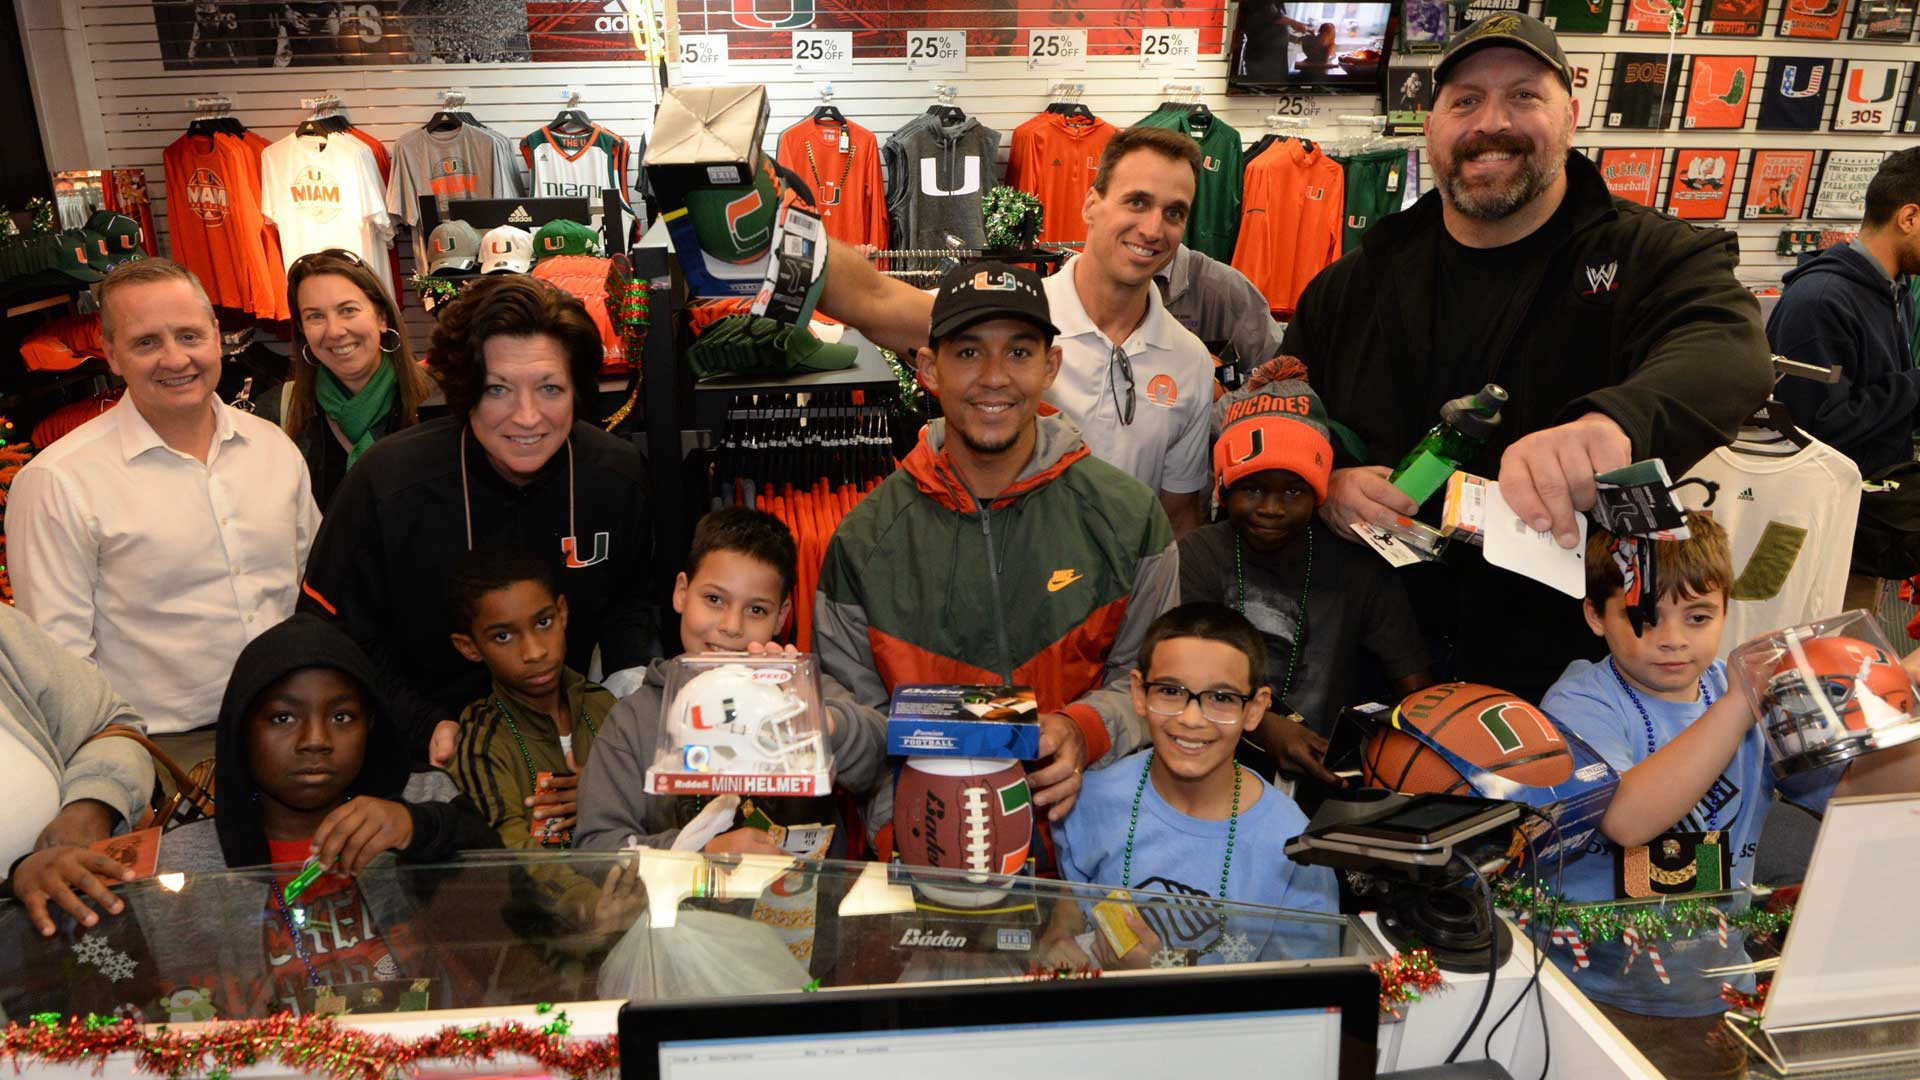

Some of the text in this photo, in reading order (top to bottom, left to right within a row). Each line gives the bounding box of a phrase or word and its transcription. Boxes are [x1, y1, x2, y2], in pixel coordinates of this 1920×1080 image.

[824, 51, 843, 61] OFF
[939, 49, 959, 58] OFF
[1060, 48, 1080, 57] OFF
[1170, 47, 1190, 56] OFF
[700, 54, 719, 63] OFF
[1847, 69, 1899, 104] U
[1303, 107, 1321, 116] OFF
[1850, 110, 1882, 124] 305
[921, 155, 981, 197] U
[561, 532, 609, 568] U
[711, 776, 742, 792] MINI
[744, 776, 812, 793] HELMET
